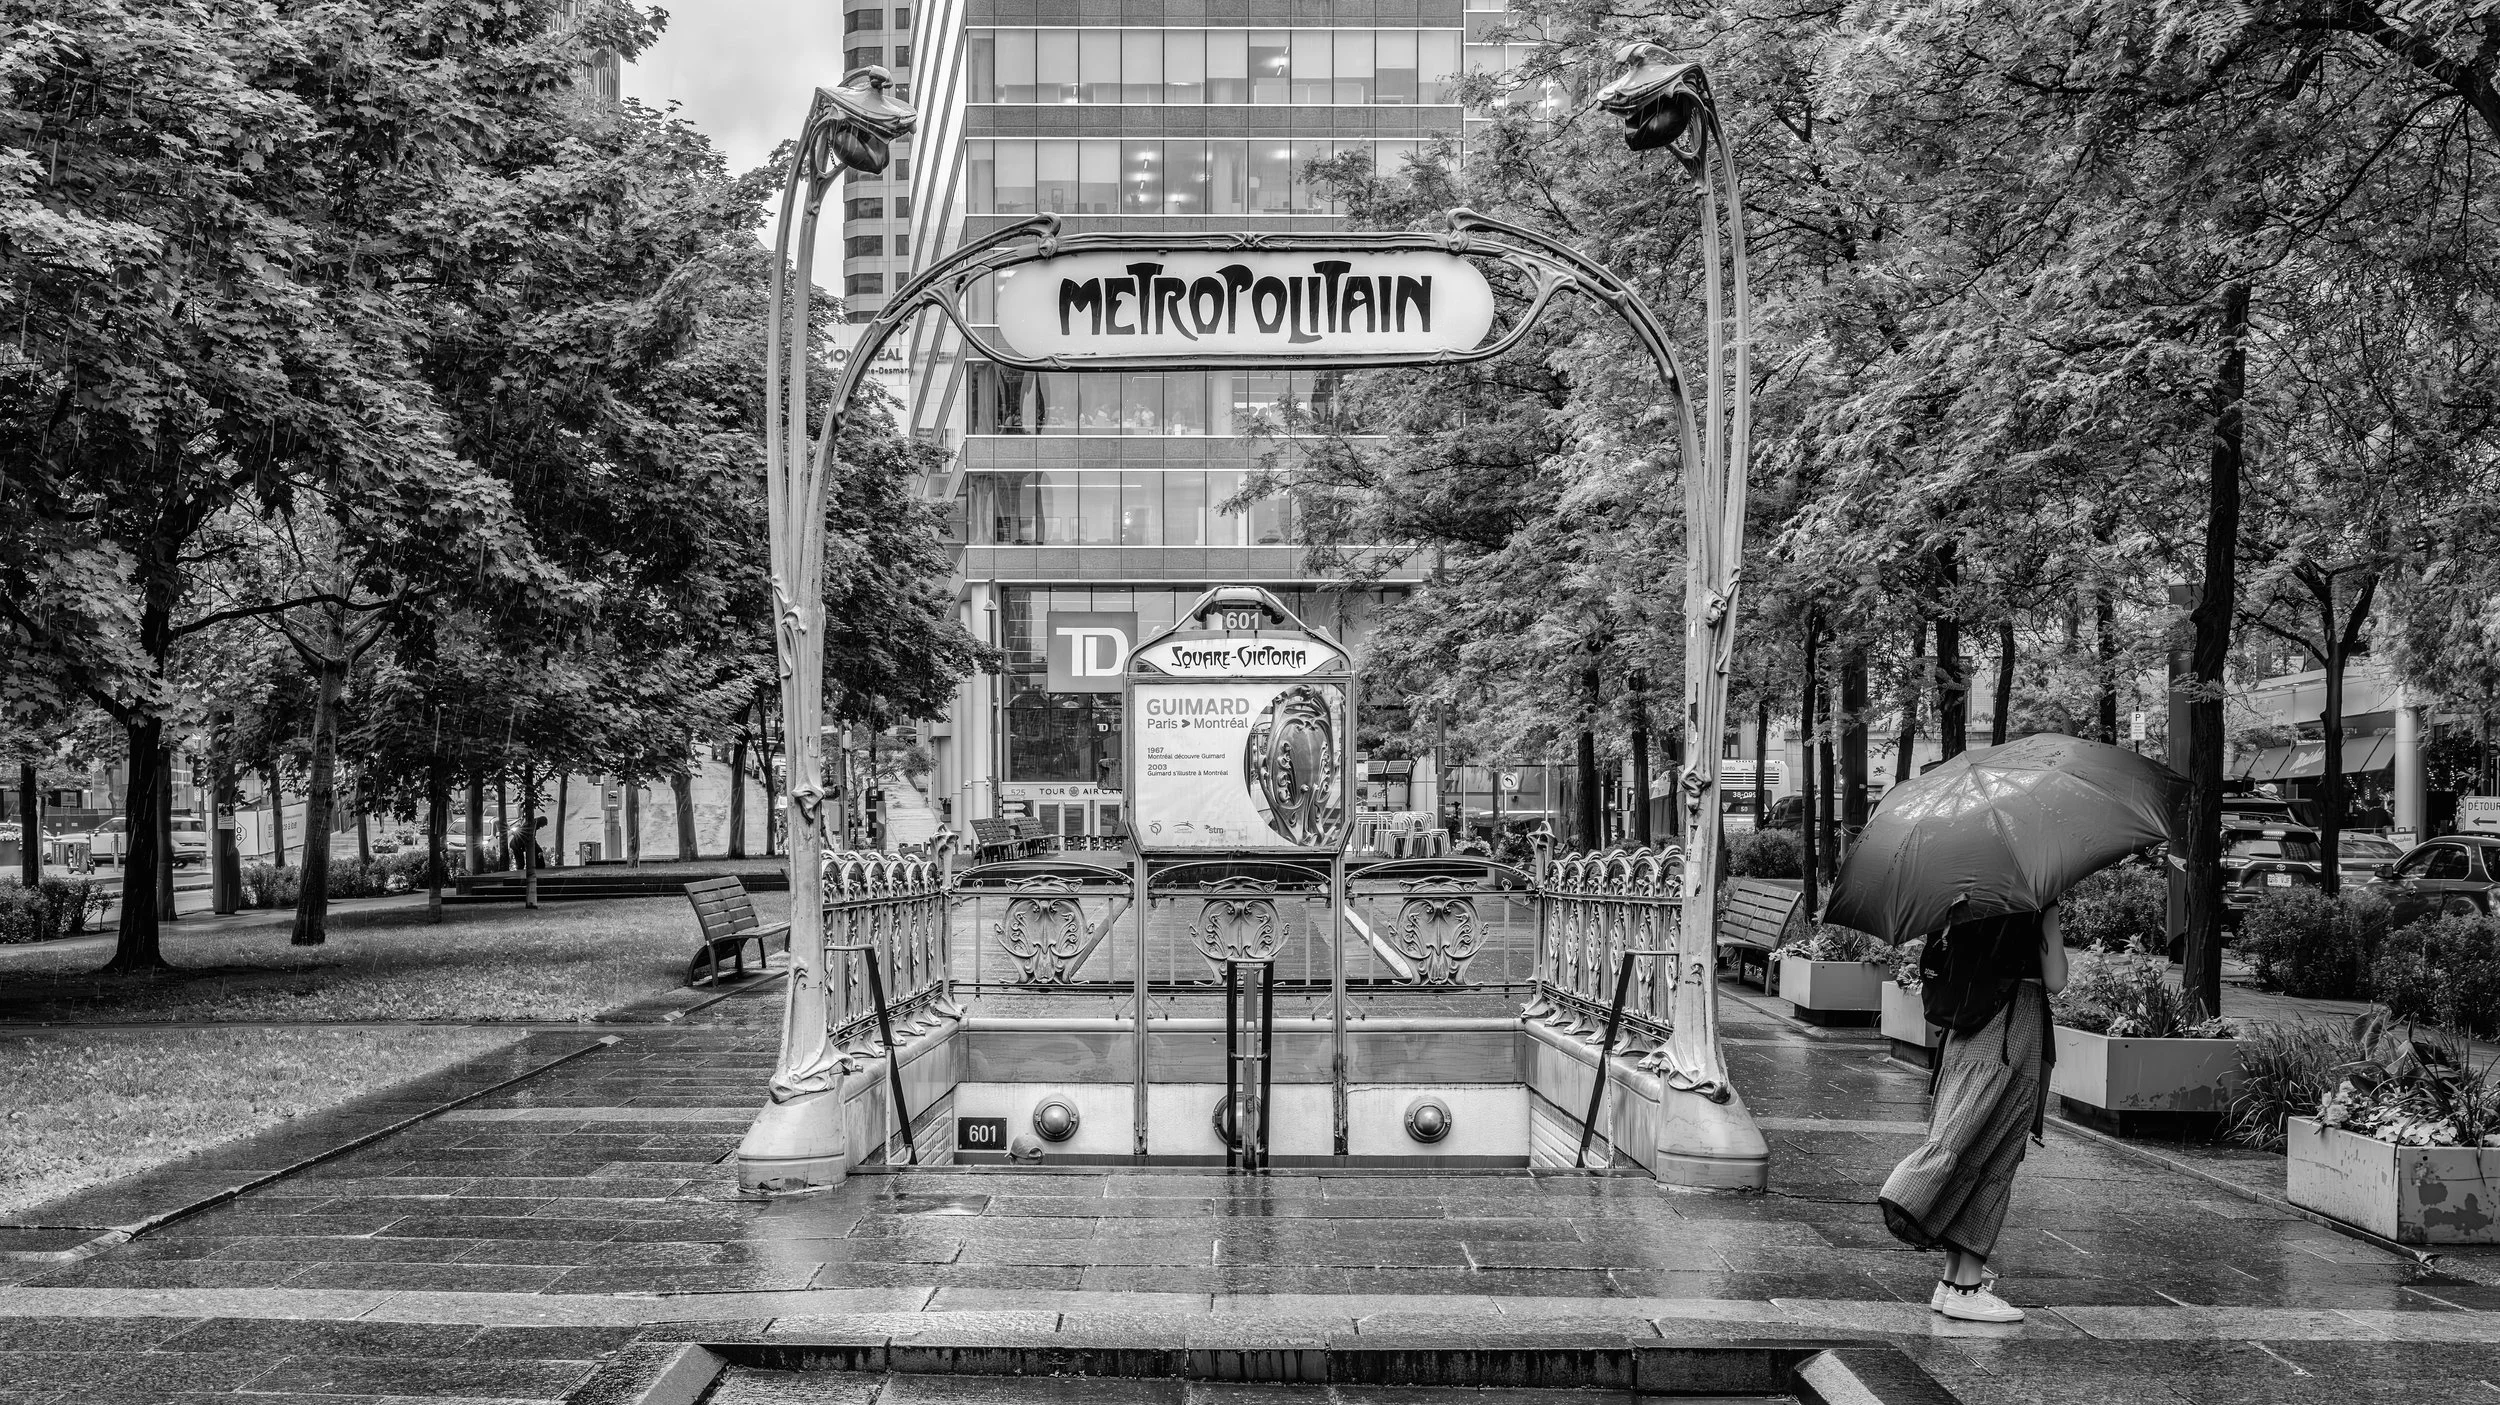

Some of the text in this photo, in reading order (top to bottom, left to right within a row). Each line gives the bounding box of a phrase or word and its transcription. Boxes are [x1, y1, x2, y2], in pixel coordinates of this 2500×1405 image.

[1058, 260, 1432, 344] METROPOLITAIN
[1226, 612, 1259, 630] 601
[1056, 627, 1129, 676] TD
[1146, 698, 1250, 715] GUIMARD
[1147, 717, 1248, 729] Paris Montréal
[2135, 713, 2141, 721] P
[1096, 723, 1109, 732] TD
[1011, 788, 1026, 796] 525
[969, 1125, 996, 1142] 601
